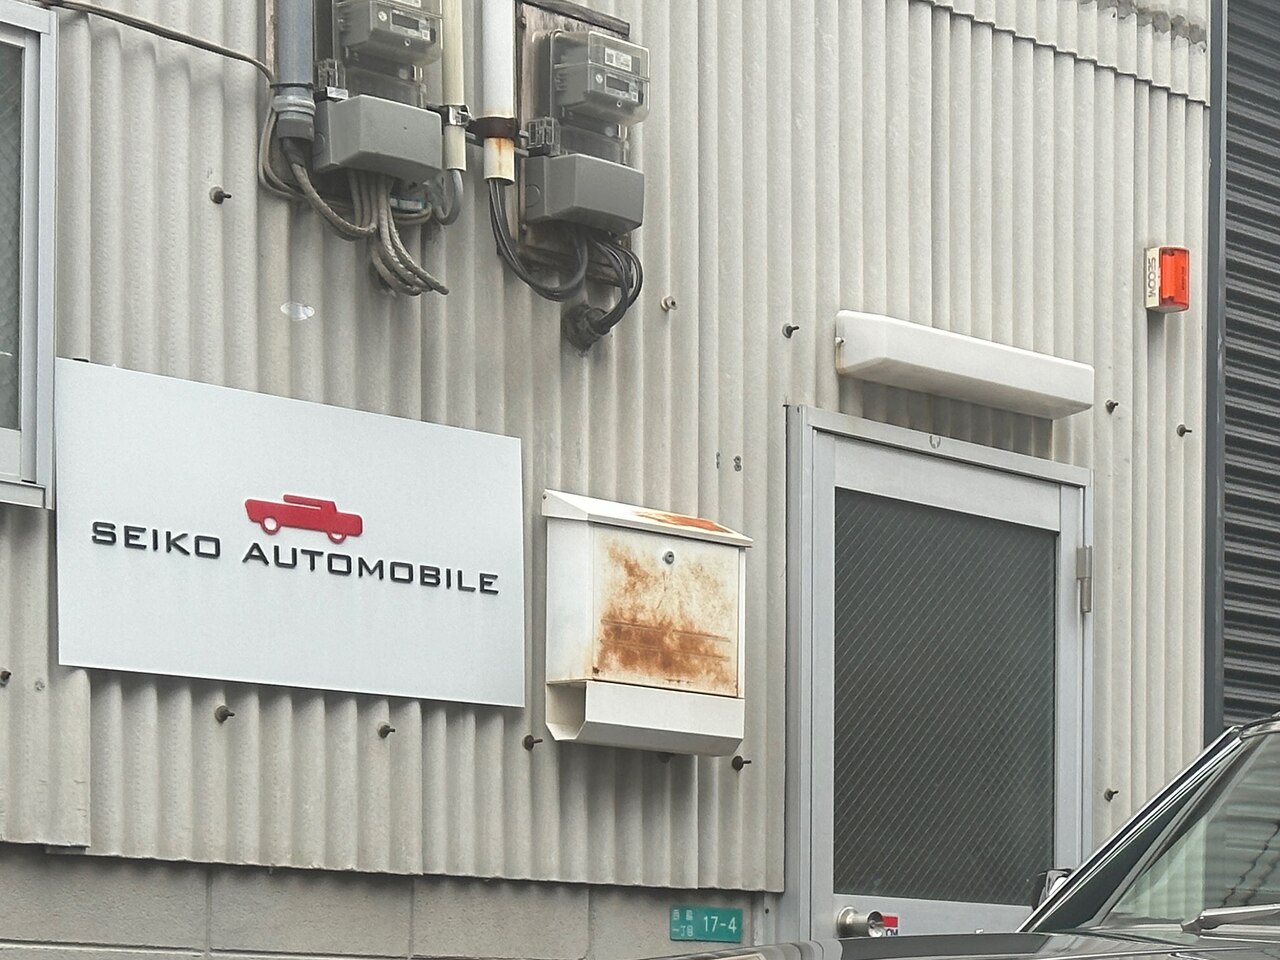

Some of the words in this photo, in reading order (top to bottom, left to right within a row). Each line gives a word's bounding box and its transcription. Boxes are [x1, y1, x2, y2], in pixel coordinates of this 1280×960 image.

[91, 521, 221, 559] SEIKO
[242, 542, 499, 595] AUTOMOBILE
[703, 915, 737, 934] 17-4
